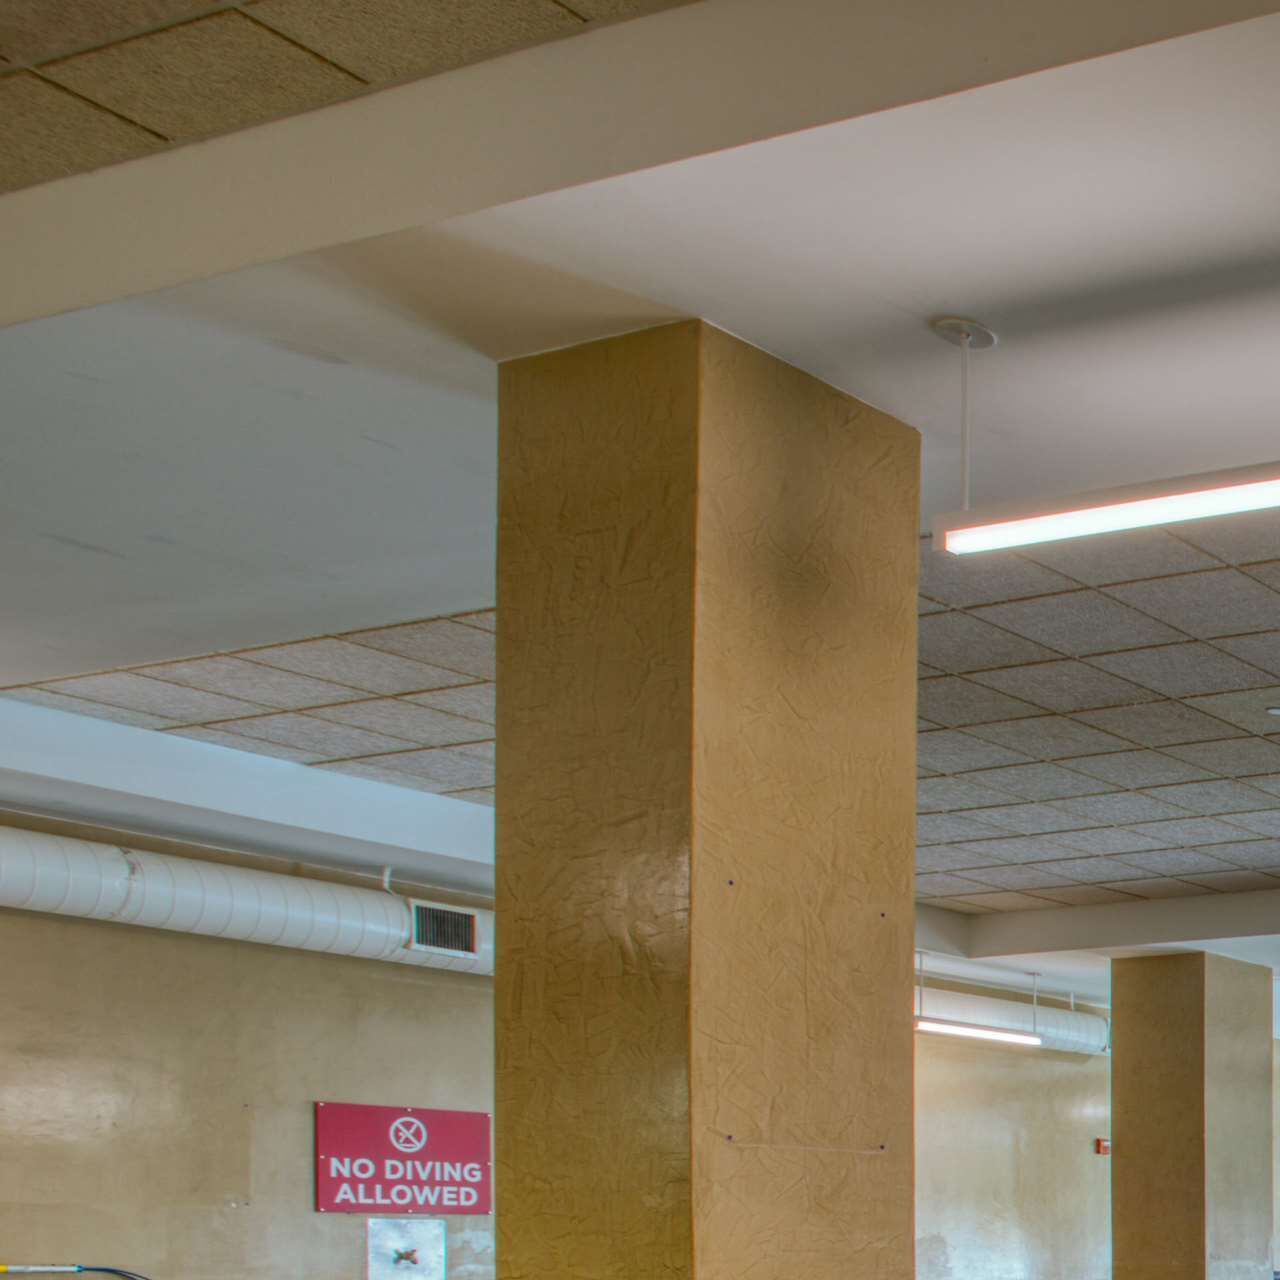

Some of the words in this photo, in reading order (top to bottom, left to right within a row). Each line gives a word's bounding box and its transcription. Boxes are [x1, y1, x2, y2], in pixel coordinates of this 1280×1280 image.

[330, 1157, 376, 1179] NO
[384, 1158, 482, 1182] DIVING
[334, 1183, 478, 1206] ALLOWED
